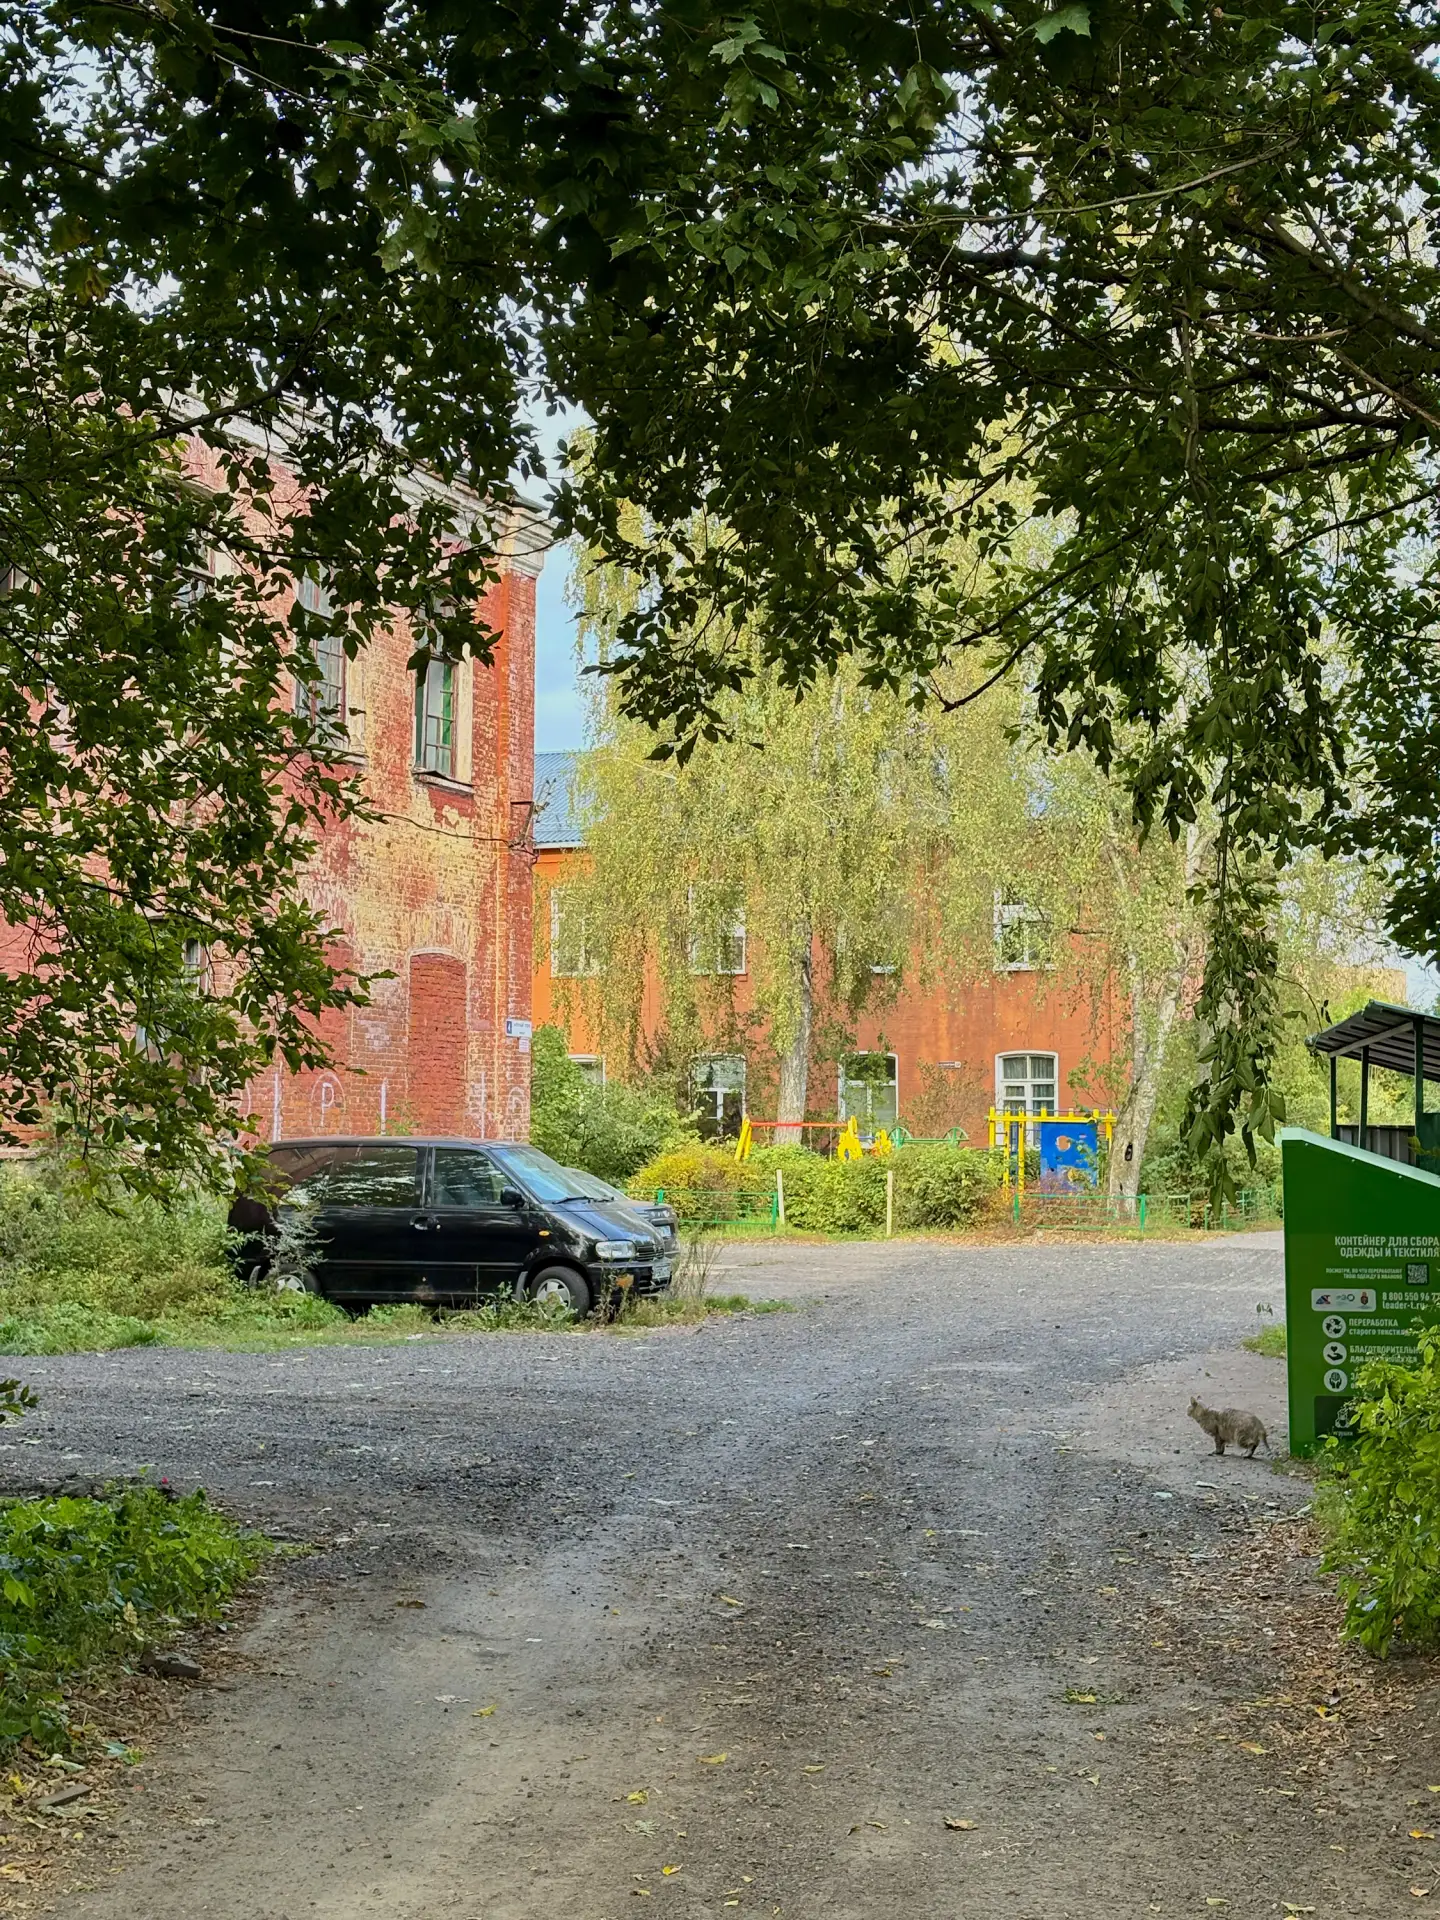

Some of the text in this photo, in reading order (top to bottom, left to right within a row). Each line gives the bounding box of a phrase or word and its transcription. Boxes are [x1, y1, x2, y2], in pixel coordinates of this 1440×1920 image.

[1335, 1234, 1440, 1247] КОНТЕЙНЕР ДЛЯ СБОРА
[1340, 1247, 1440, 1258] ОДЕЖДЫ И ТЕКСТИЛЯ
[1382, 1291, 1387, 1301] 8
[1388, 1291, 1403, 1301] 800
[1404, 1292, 1419, 1301] 550
[1420, 1292, 1430, 1301] 96
[1382, 1301, 1425, 1310] leader-t.ru
[1349, 1318, 1398, 1327] ПЕРЕРАБОТКА
[1349, 1328, 1376, 1336] старого
[1349, 1345, 1418, 1353] БЛАГОТВОРИТЕЛЬН
